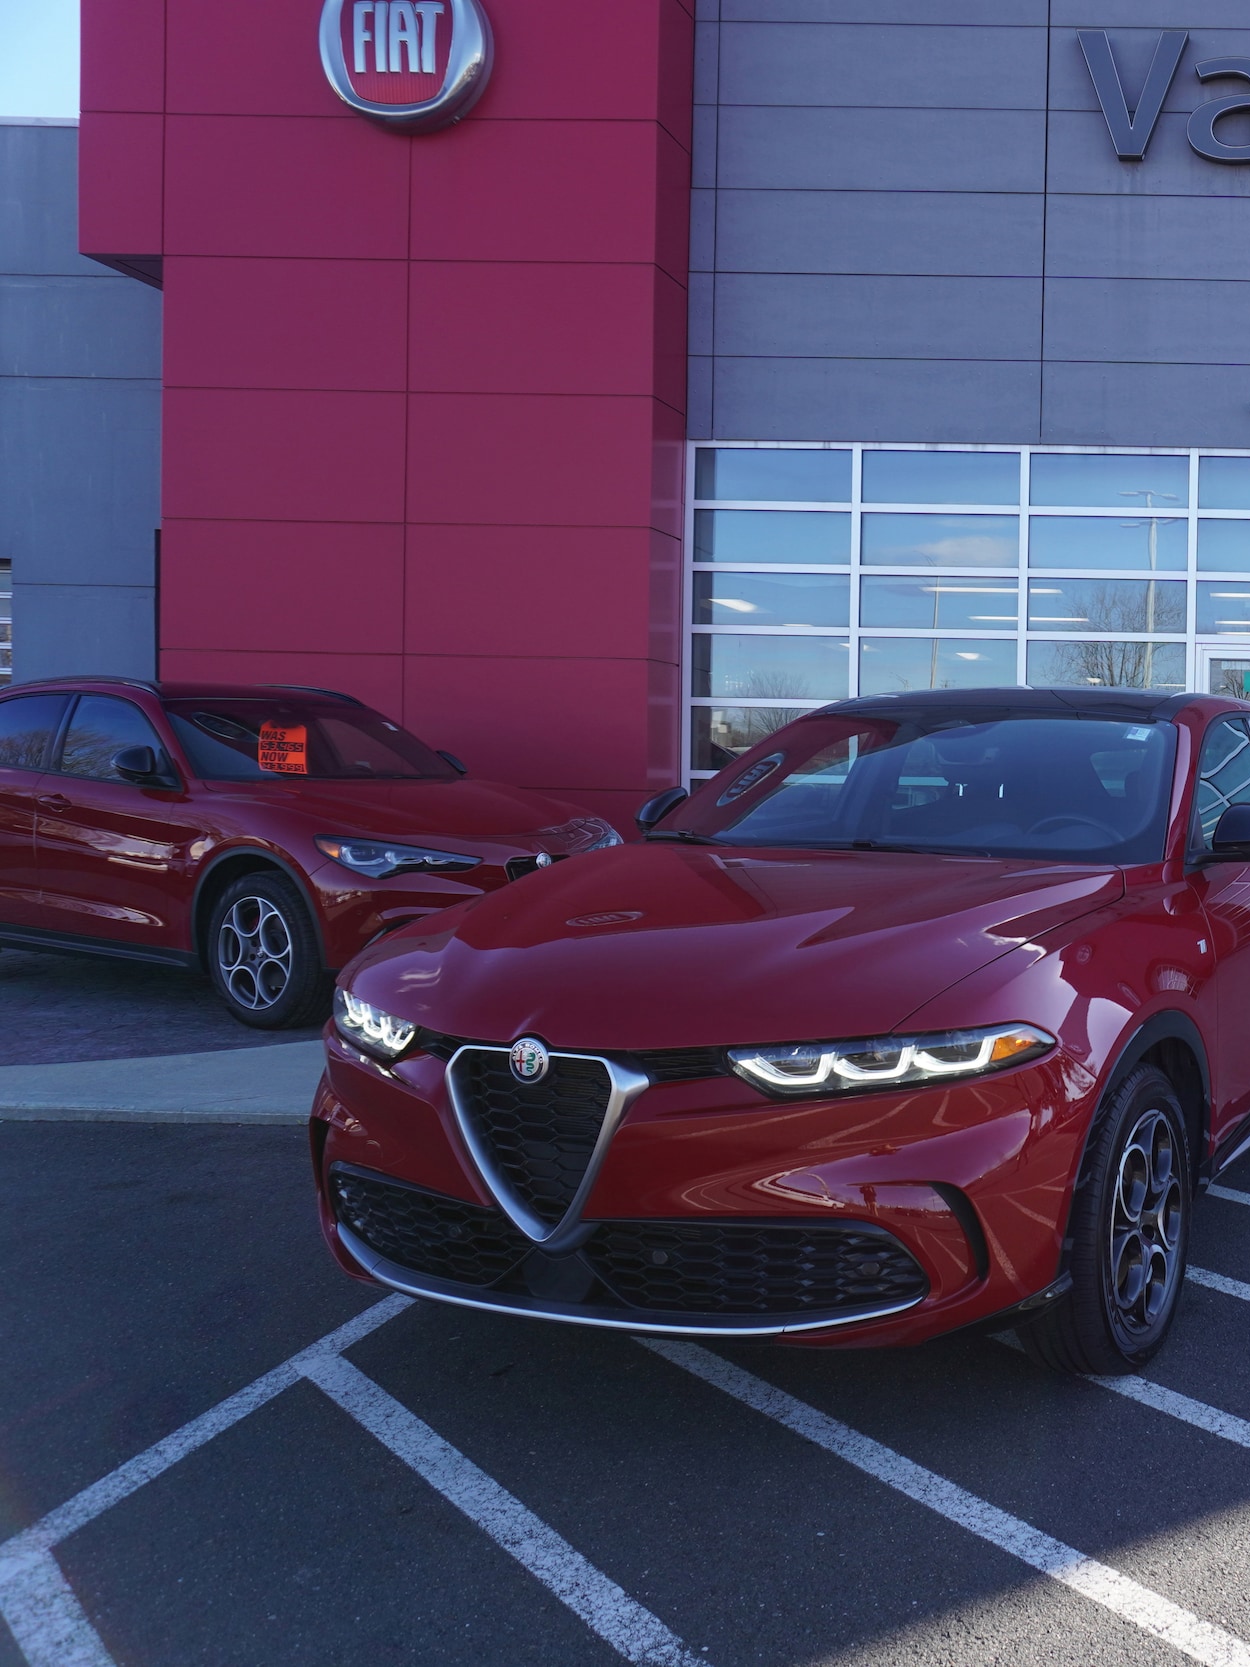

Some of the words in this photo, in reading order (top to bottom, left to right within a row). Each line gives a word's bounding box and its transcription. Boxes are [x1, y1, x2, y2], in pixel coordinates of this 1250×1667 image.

[353, 1, 445, 74] FIAT
[261, 730, 286, 740] WAS
[261, 752, 288, 761] NOW
